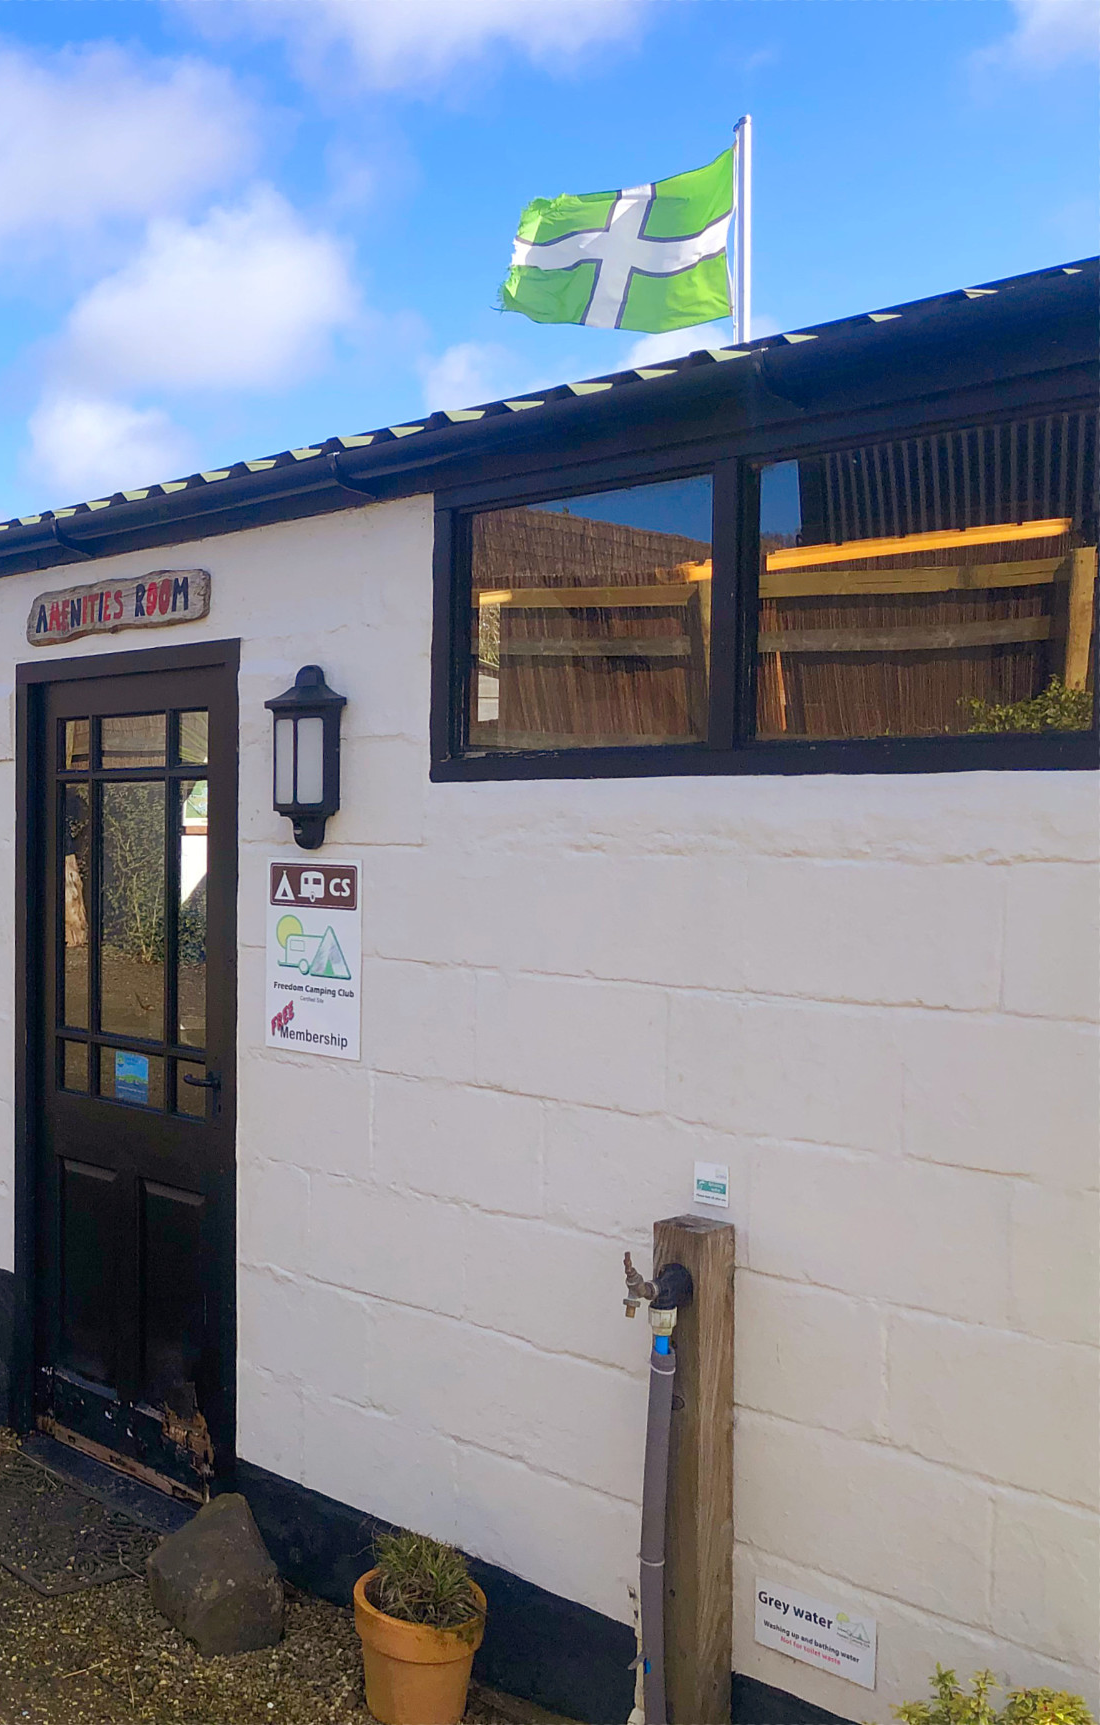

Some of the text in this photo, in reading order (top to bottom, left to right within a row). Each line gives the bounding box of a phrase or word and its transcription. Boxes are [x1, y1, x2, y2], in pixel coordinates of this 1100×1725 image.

[35, 576, 189, 633] AMENITIES ROOM
[329, 878, 351, 897] CS
[273, 981, 355, 998] Freedom Camping Club
[271, 1000, 295, 1036] FREE
[280, 1025, 348, 1050] Membership
[758, 1591, 833, 1629] Grey water
[763, 1619, 790, 1637] Washing
[791, 1631, 800, 1639] up
[801, 1634, 814, 1645] and
[814, 1639, 840, 1656] bathing
[840, 1651, 860, 1663] water
[780, 1636, 841, 1665] Not for toilet waste
